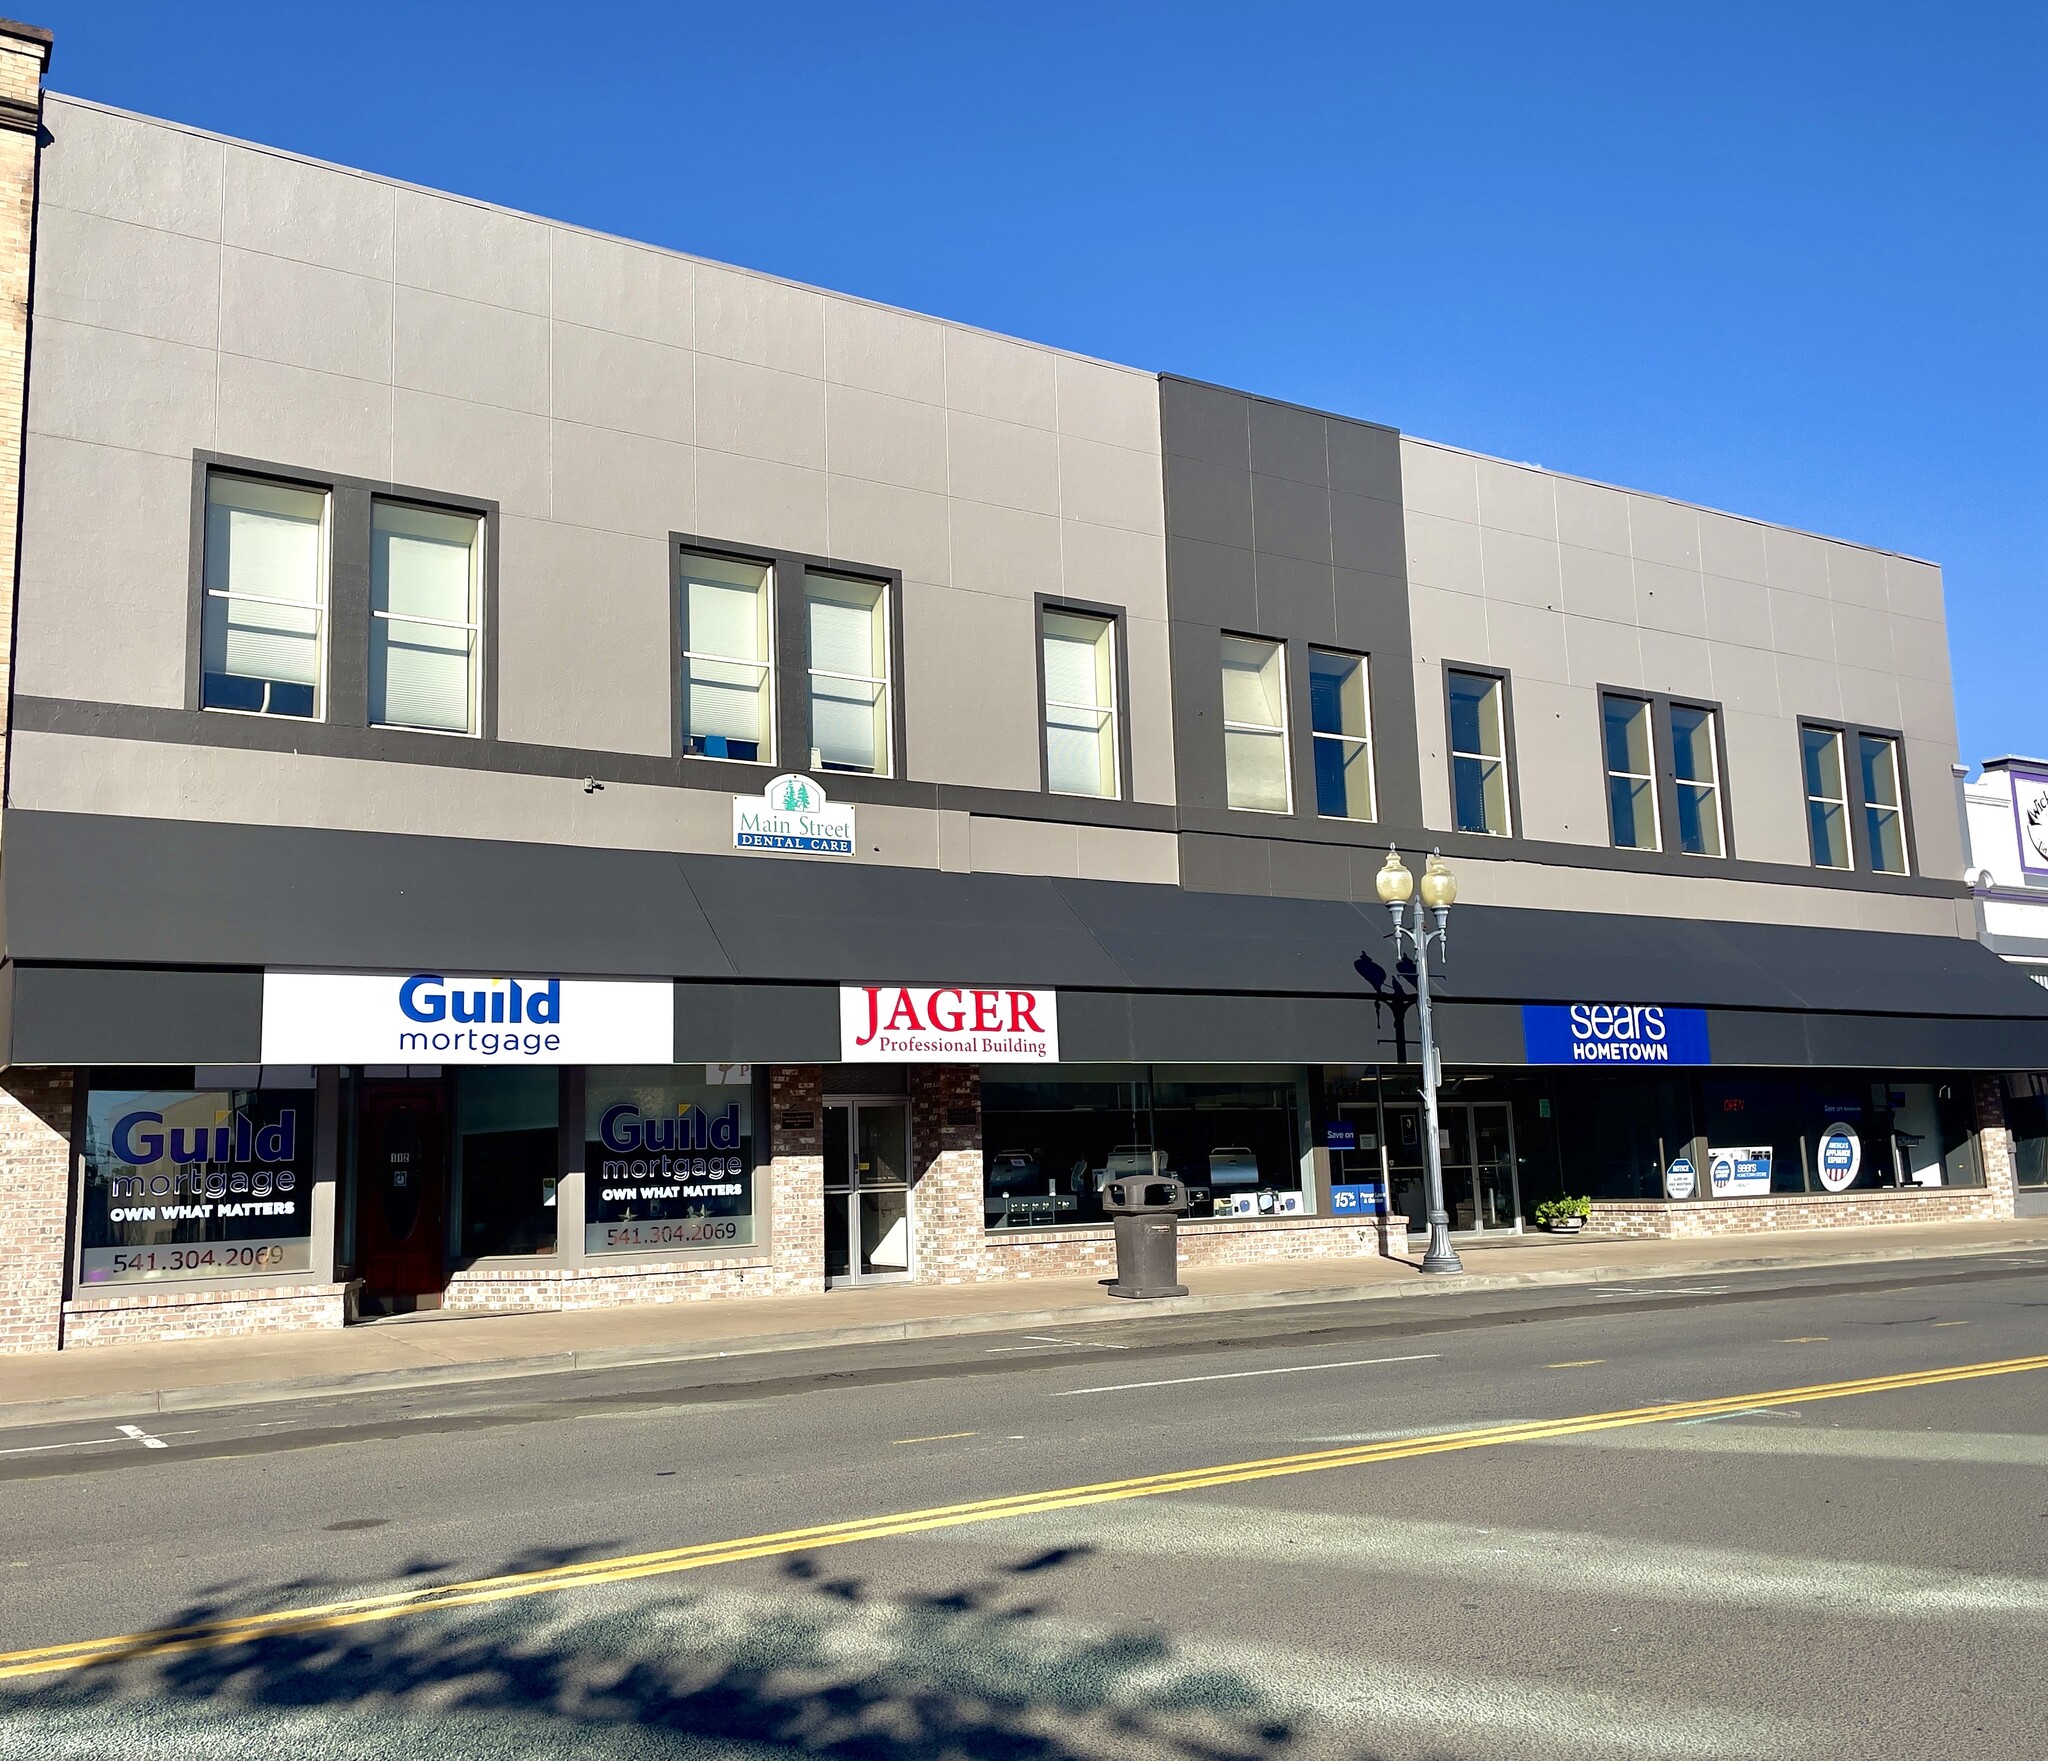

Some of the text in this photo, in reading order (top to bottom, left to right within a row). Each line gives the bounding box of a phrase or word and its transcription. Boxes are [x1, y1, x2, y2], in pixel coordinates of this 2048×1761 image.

[740, 812, 850, 839] Main Street
[741, 834, 849, 852] DENTAL CARE
[399, 974, 561, 1025] Guild
[856, 986, 1046, 1047] JAGER
[1570, 1003, 1666, 1041] sears
[400, 1029, 561, 1055] mortgage
[880, 1036, 1047, 1058] Professional Building
[1573, 1042, 1669, 1061] HOMETOWN
[1724, 1099, 1745, 1111] OPEN
[112, 1109, 296, 1166] Guild
[600, 1103, 741, 1153] Guild
[1327, 1130, 1354, 1139] Save on
[602, 1155, 742, 1181] mortgage
[112, 1169, 296, 1198] mortgage
[602, 1183, 742, 1201] OWN WHAT MATTERS
[110, 1202, 295, 1222] OWN WHAT MATTERS
[607, 1222, 737, 1246] 541.304.2069
[113, 1245, 284, 1273] 541.304.2069
